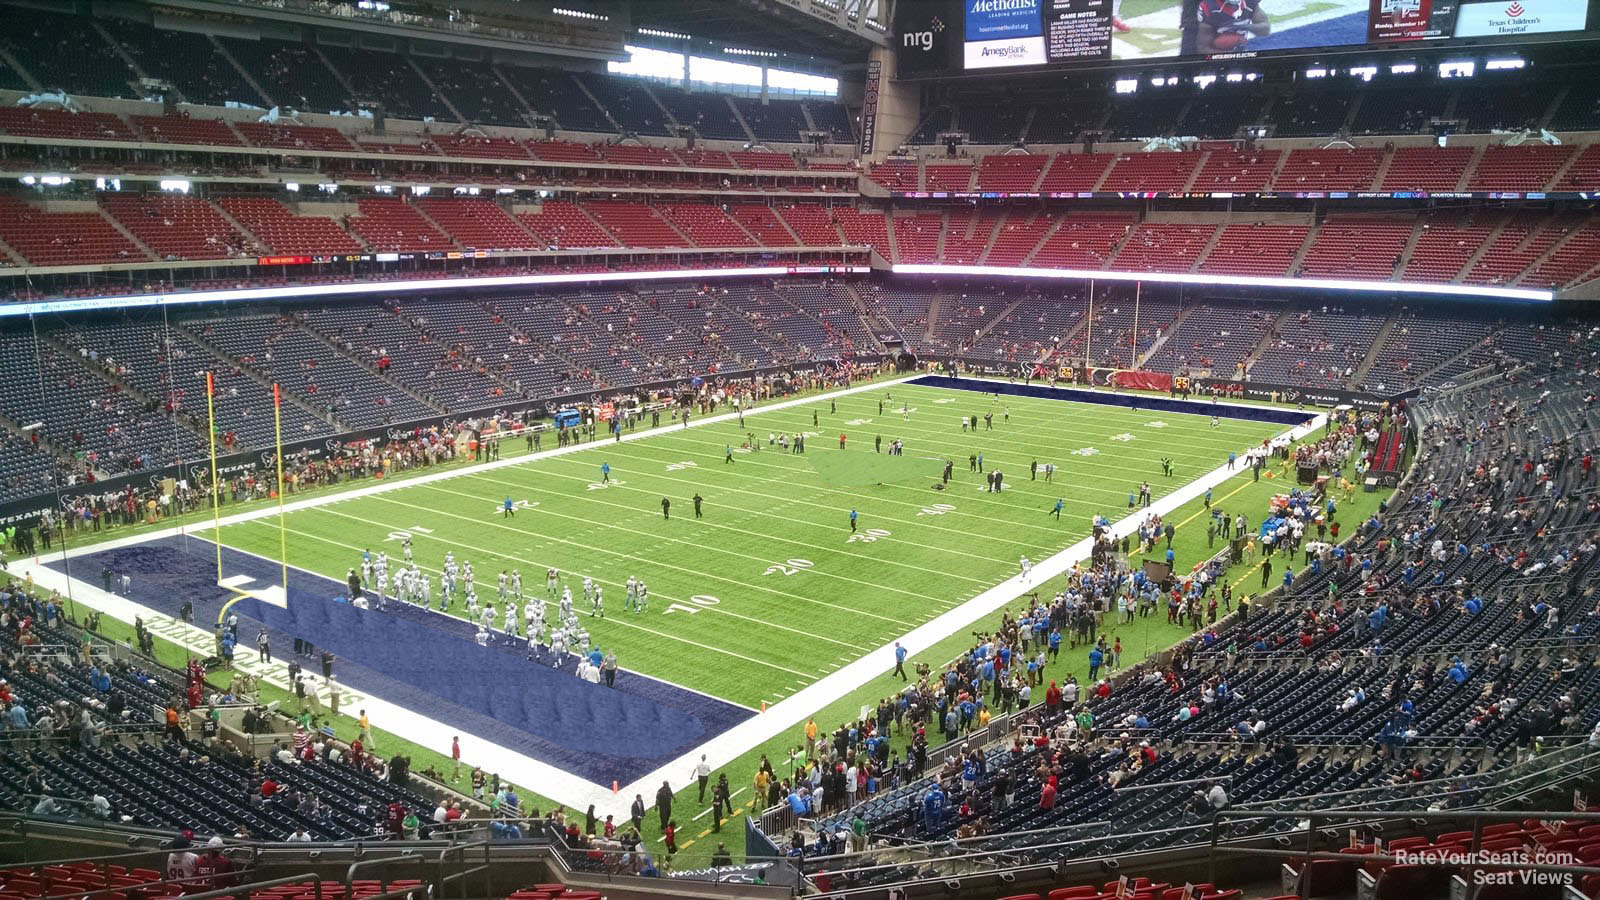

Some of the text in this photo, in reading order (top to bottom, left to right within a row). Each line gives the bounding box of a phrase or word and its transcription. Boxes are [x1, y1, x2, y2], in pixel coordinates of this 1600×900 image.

[970, 0, 1037, 13] Methodist
[904, 32, 932, 51] nrg
[982, 44, 1026, 56] AmegyBank
[1177, 378, 1188, 388] 25
[217, 462, 257, 474] TEXANS
[766, 558, 814, 576] 20
[664, 594, 720, 614] 10
[374, 827, 384, 835] 99
[170, 868, 184, 880] 99
